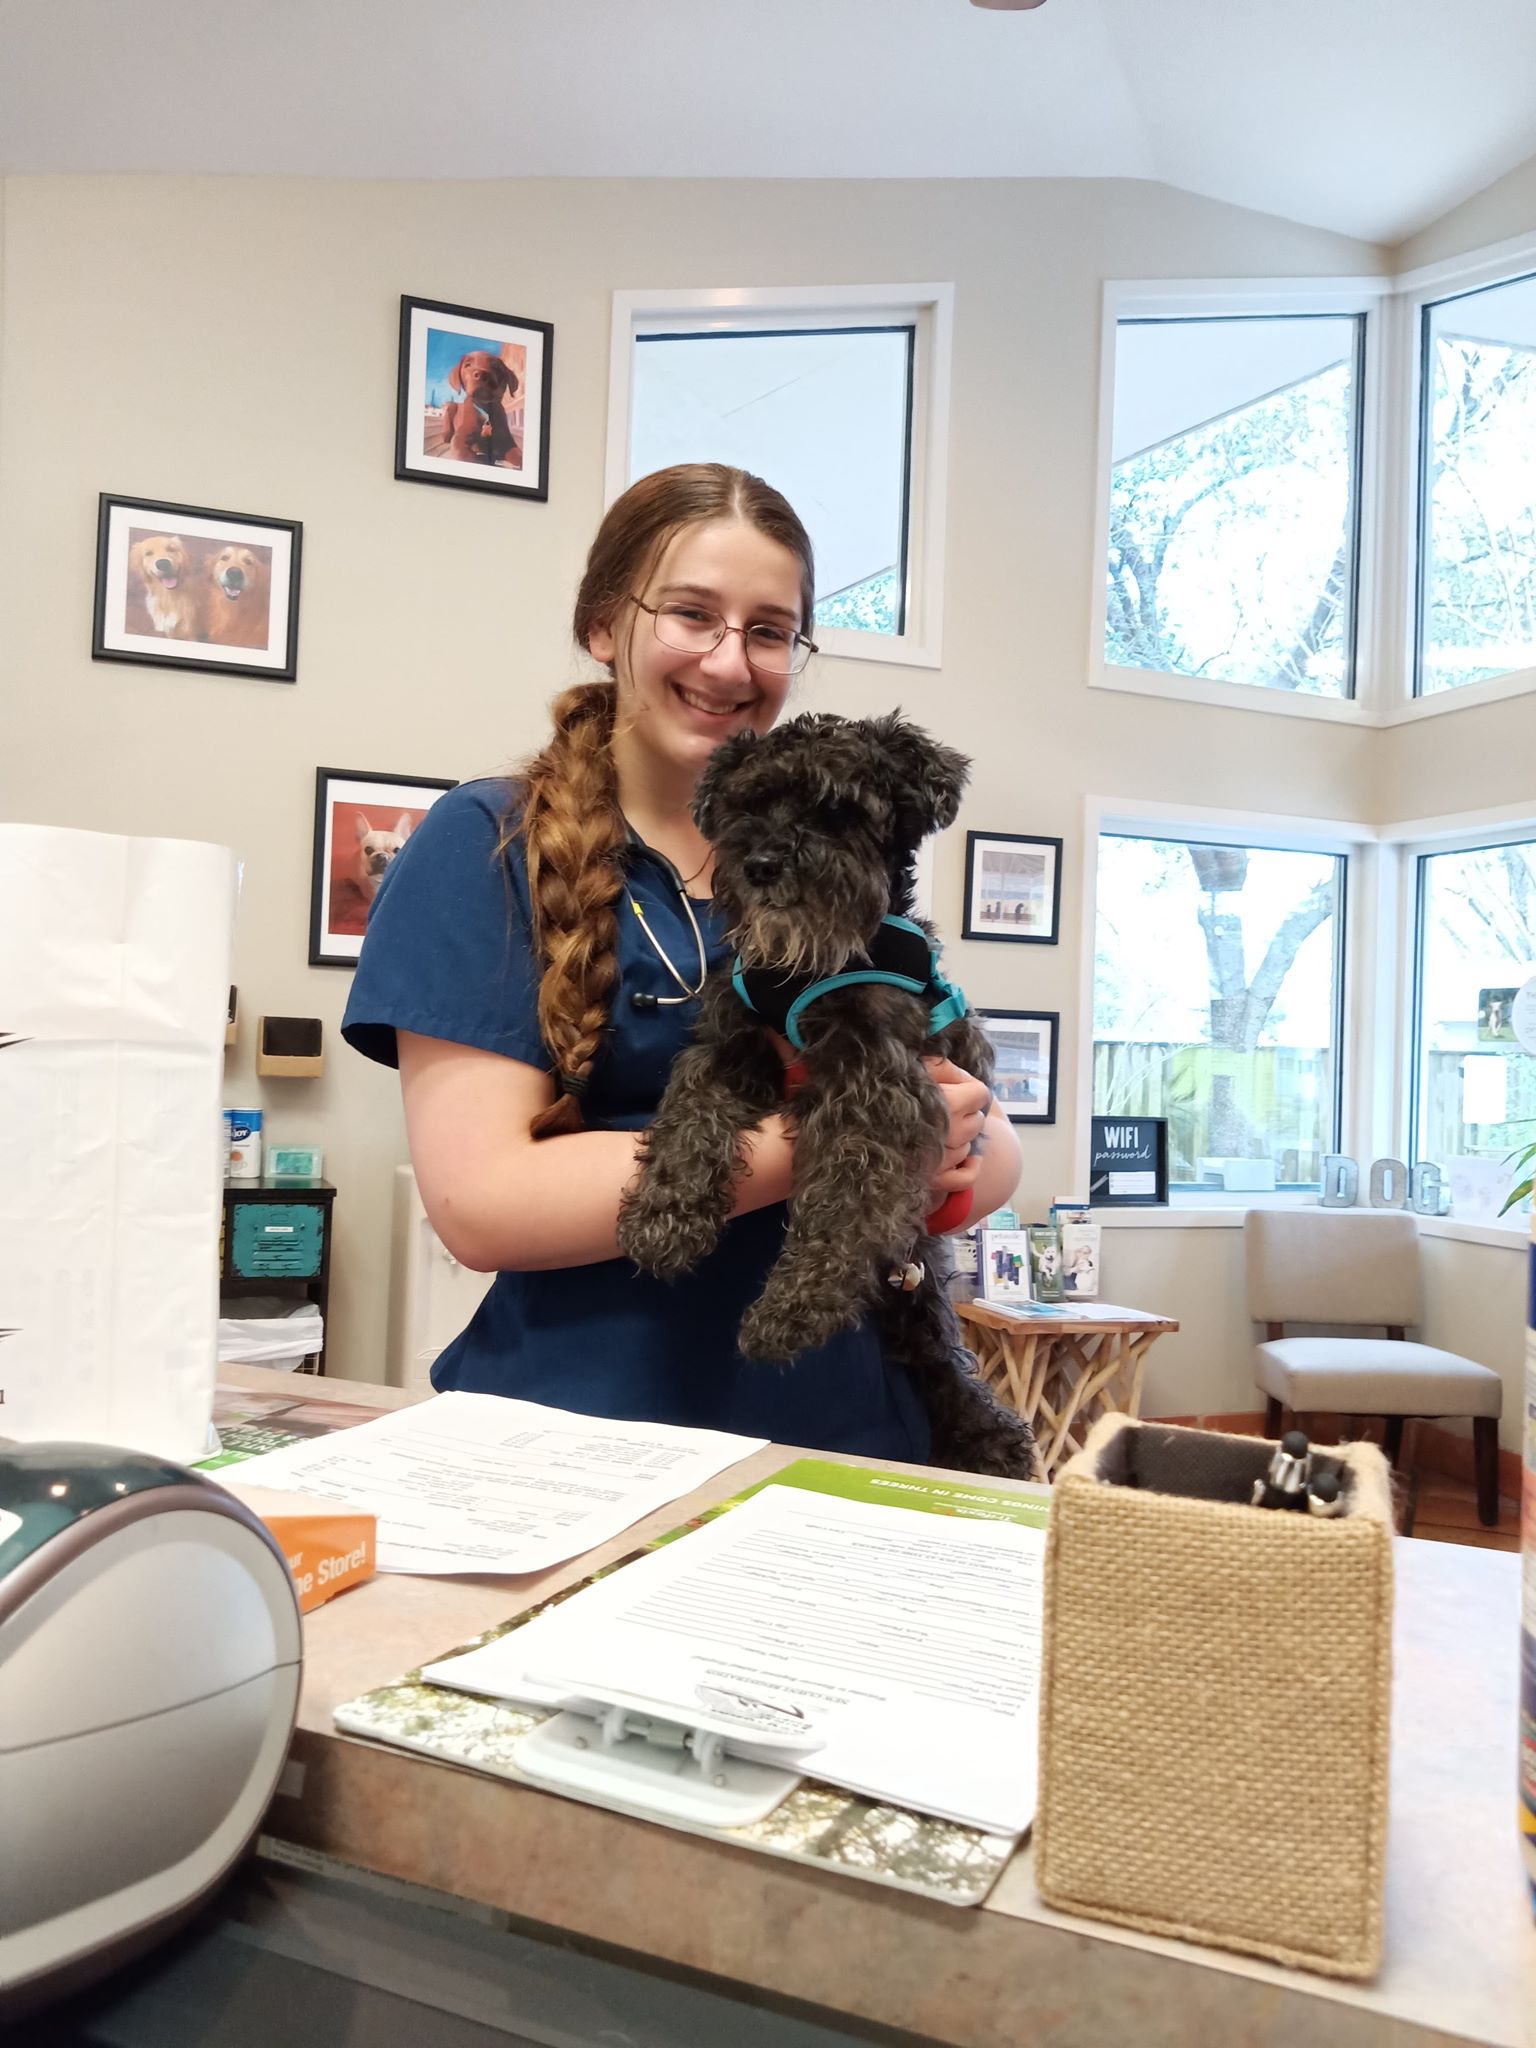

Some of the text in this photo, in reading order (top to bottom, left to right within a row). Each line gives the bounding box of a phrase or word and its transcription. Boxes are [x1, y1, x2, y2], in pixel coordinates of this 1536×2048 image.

[1104, 1126, 1138, 1148] WIFI
[1093, 1144, 1152, 1167] password
[1318, 1154, 1450, 1216] DOG
[869, 1478, 929, 1493] THREES
[932, 1488, 950, 1497] IN
[952, 1492, 998, 1504] COME
[1002, 1500, 1051, 1512] HINGS
[317, 1541, 366, 1585] Store!
